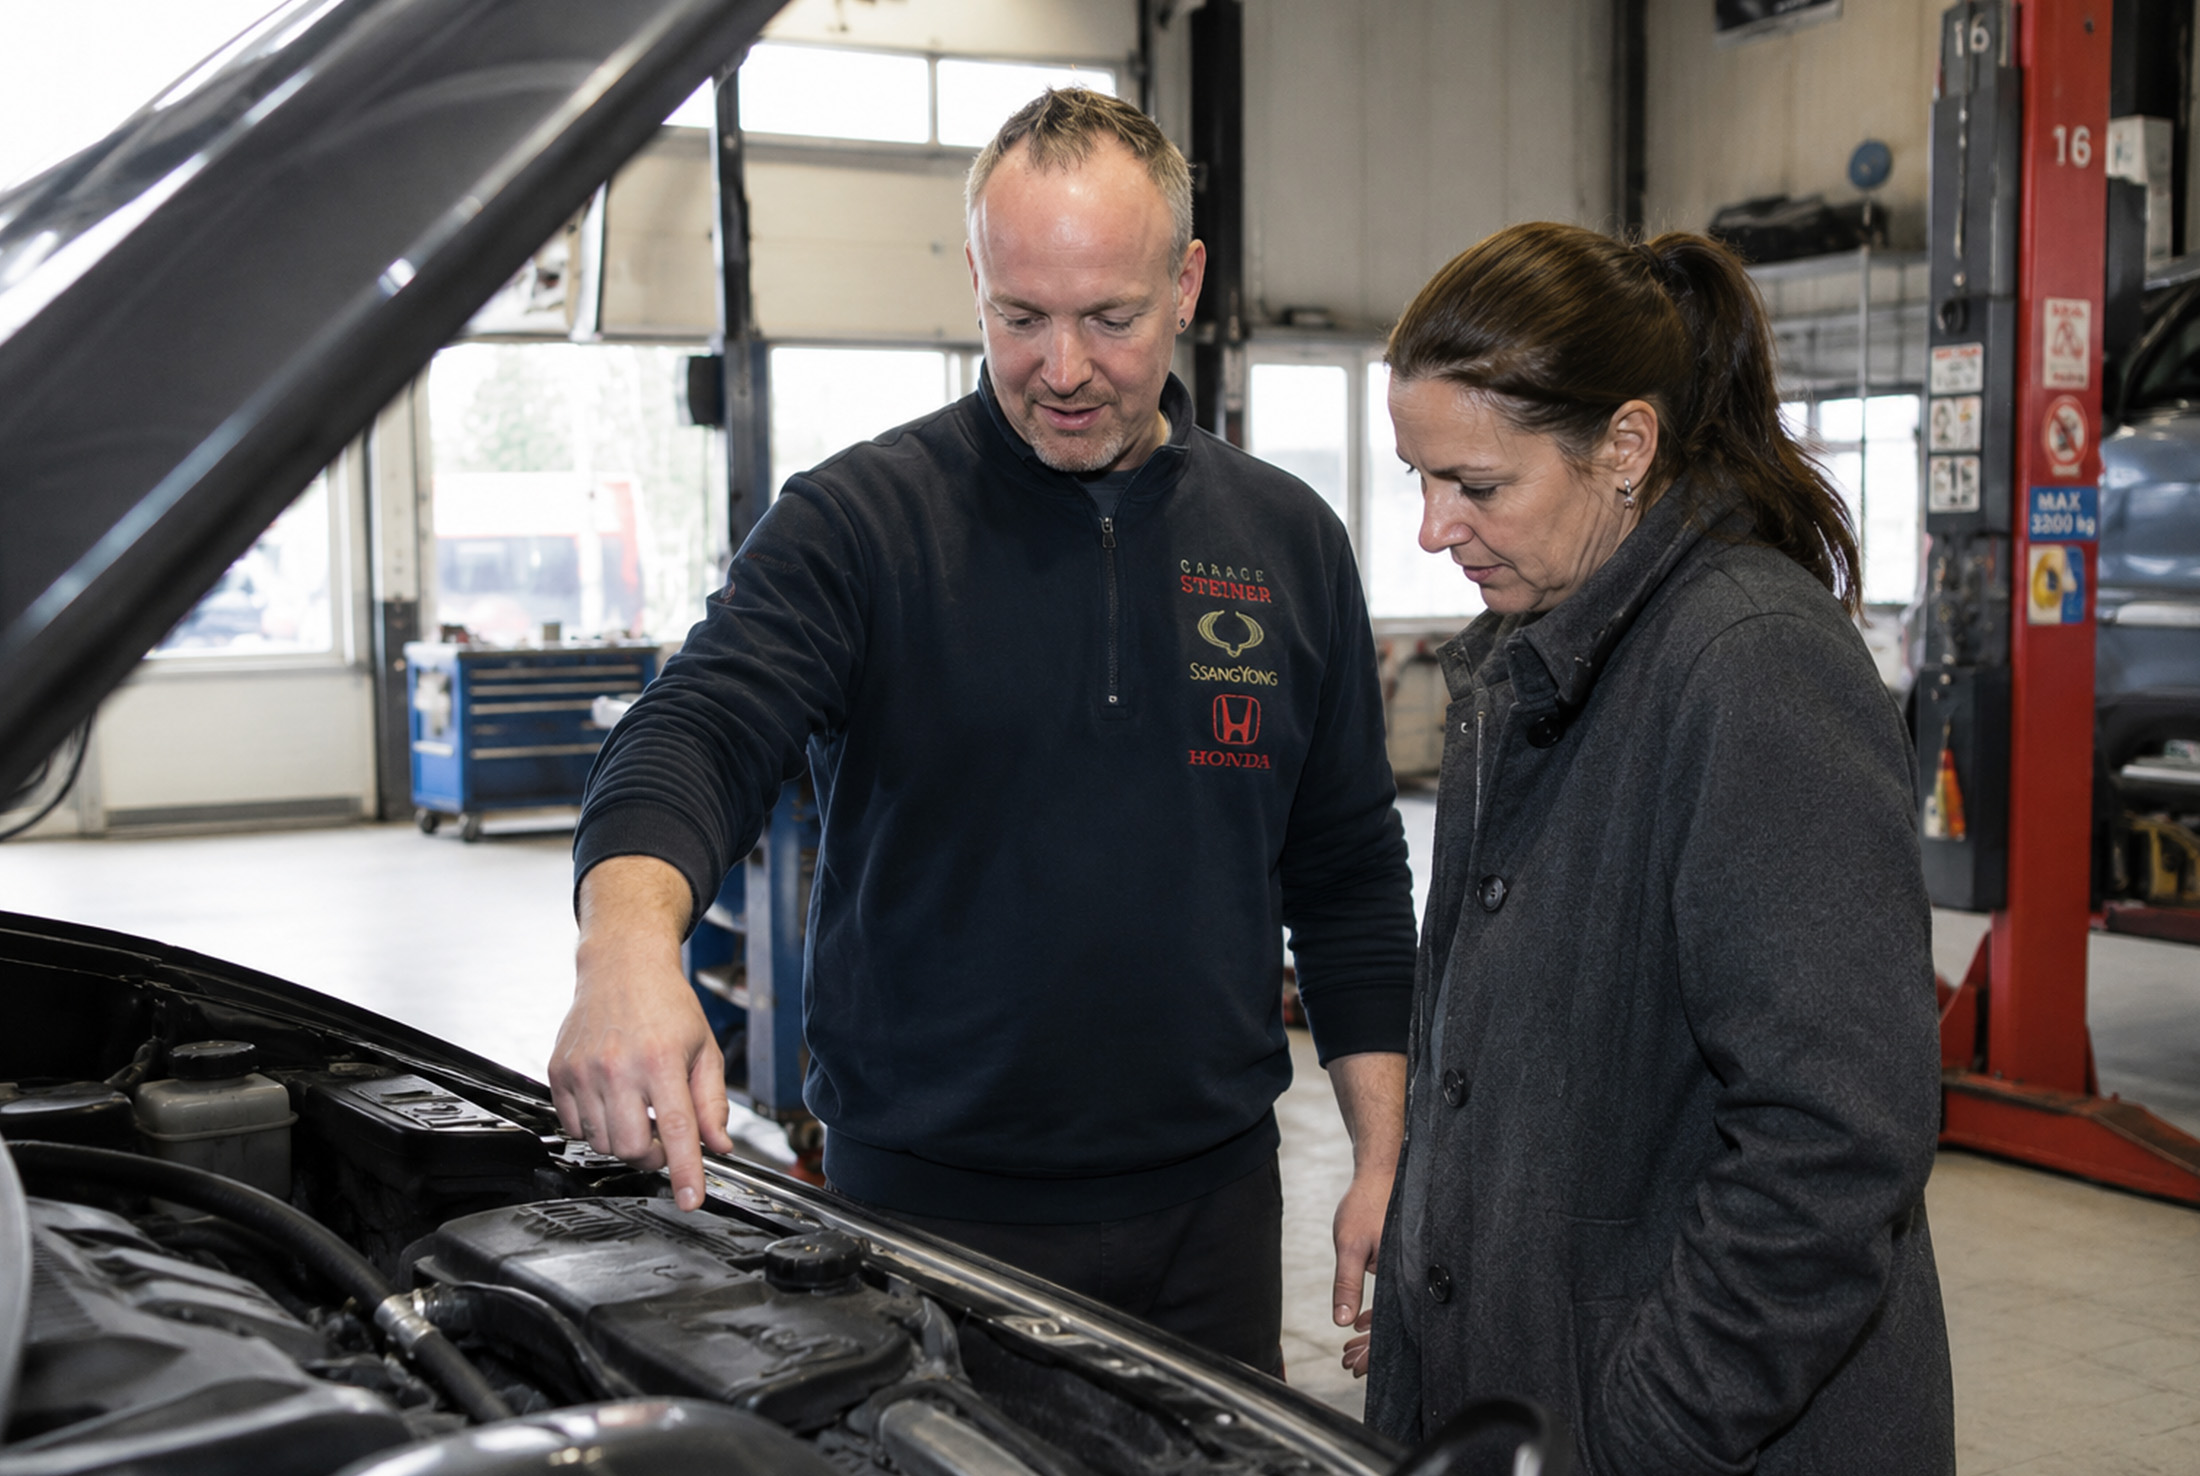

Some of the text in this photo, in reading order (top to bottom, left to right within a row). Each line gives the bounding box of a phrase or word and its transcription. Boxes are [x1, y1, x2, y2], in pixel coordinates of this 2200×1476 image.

[1954, 13, 1990, 57] 16
[2053, 124, 2092, 168] 16
[2037, 491, 2081, 512] MAX
[1180, 574, 1272, 603] STEINER
[1188, 749, 1271, 769] HONDA
